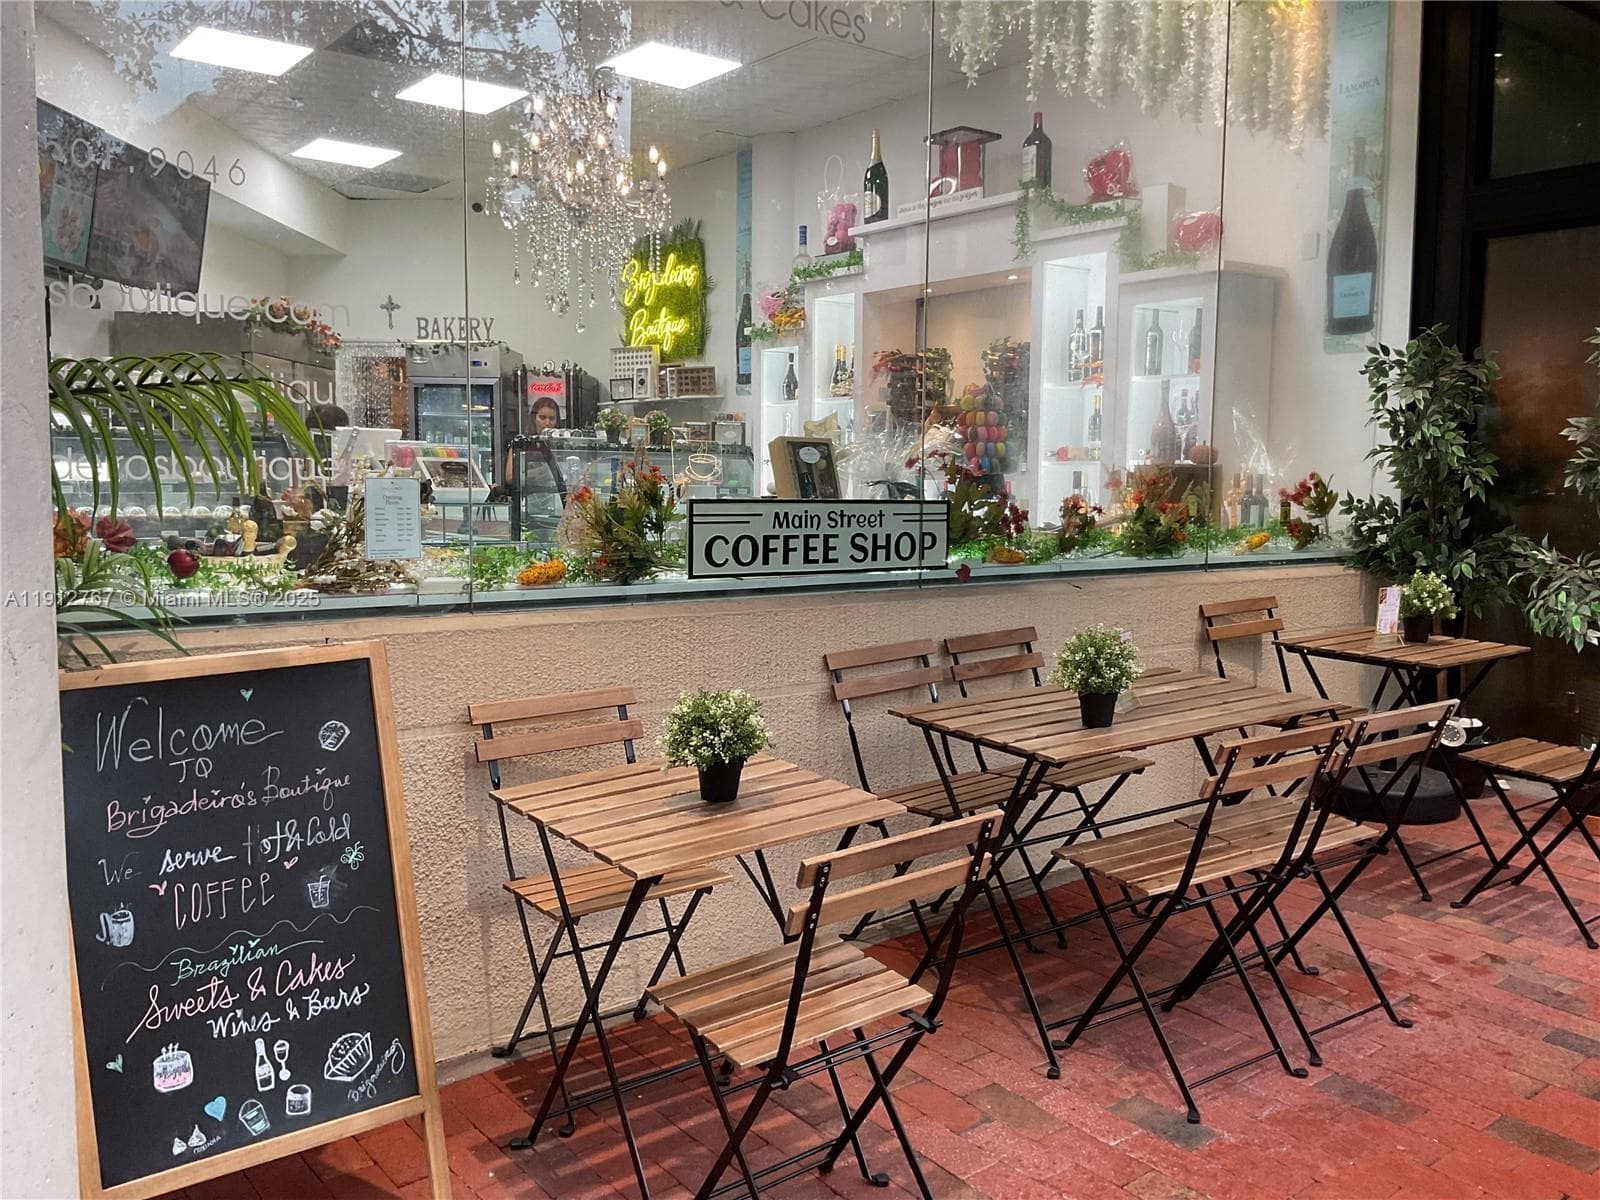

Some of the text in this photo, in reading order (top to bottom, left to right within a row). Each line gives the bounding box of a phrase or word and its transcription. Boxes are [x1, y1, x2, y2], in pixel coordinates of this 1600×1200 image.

[416, 316, 495, 342] BAKERY
[772, 509, 886, 531] Main Street
[704, 531, 938, 568] COFFEE SHOP
[97, 697, 285, 772] Welcome
[262, 765, 351, 811] Boutique
[98, 852, 142, 886] We
[159, 844, 237, 876] serve
[306, 813, 351, 846] Cold
[173, 872, 275, 930] COFFEE
[170, 939, 296, 986] Brazilian
[127, 952, 356, 1043] Sweets & Cakes
[206, 1008, 281, 1039] Wines
[302, 982, 370, 1021] Beers
